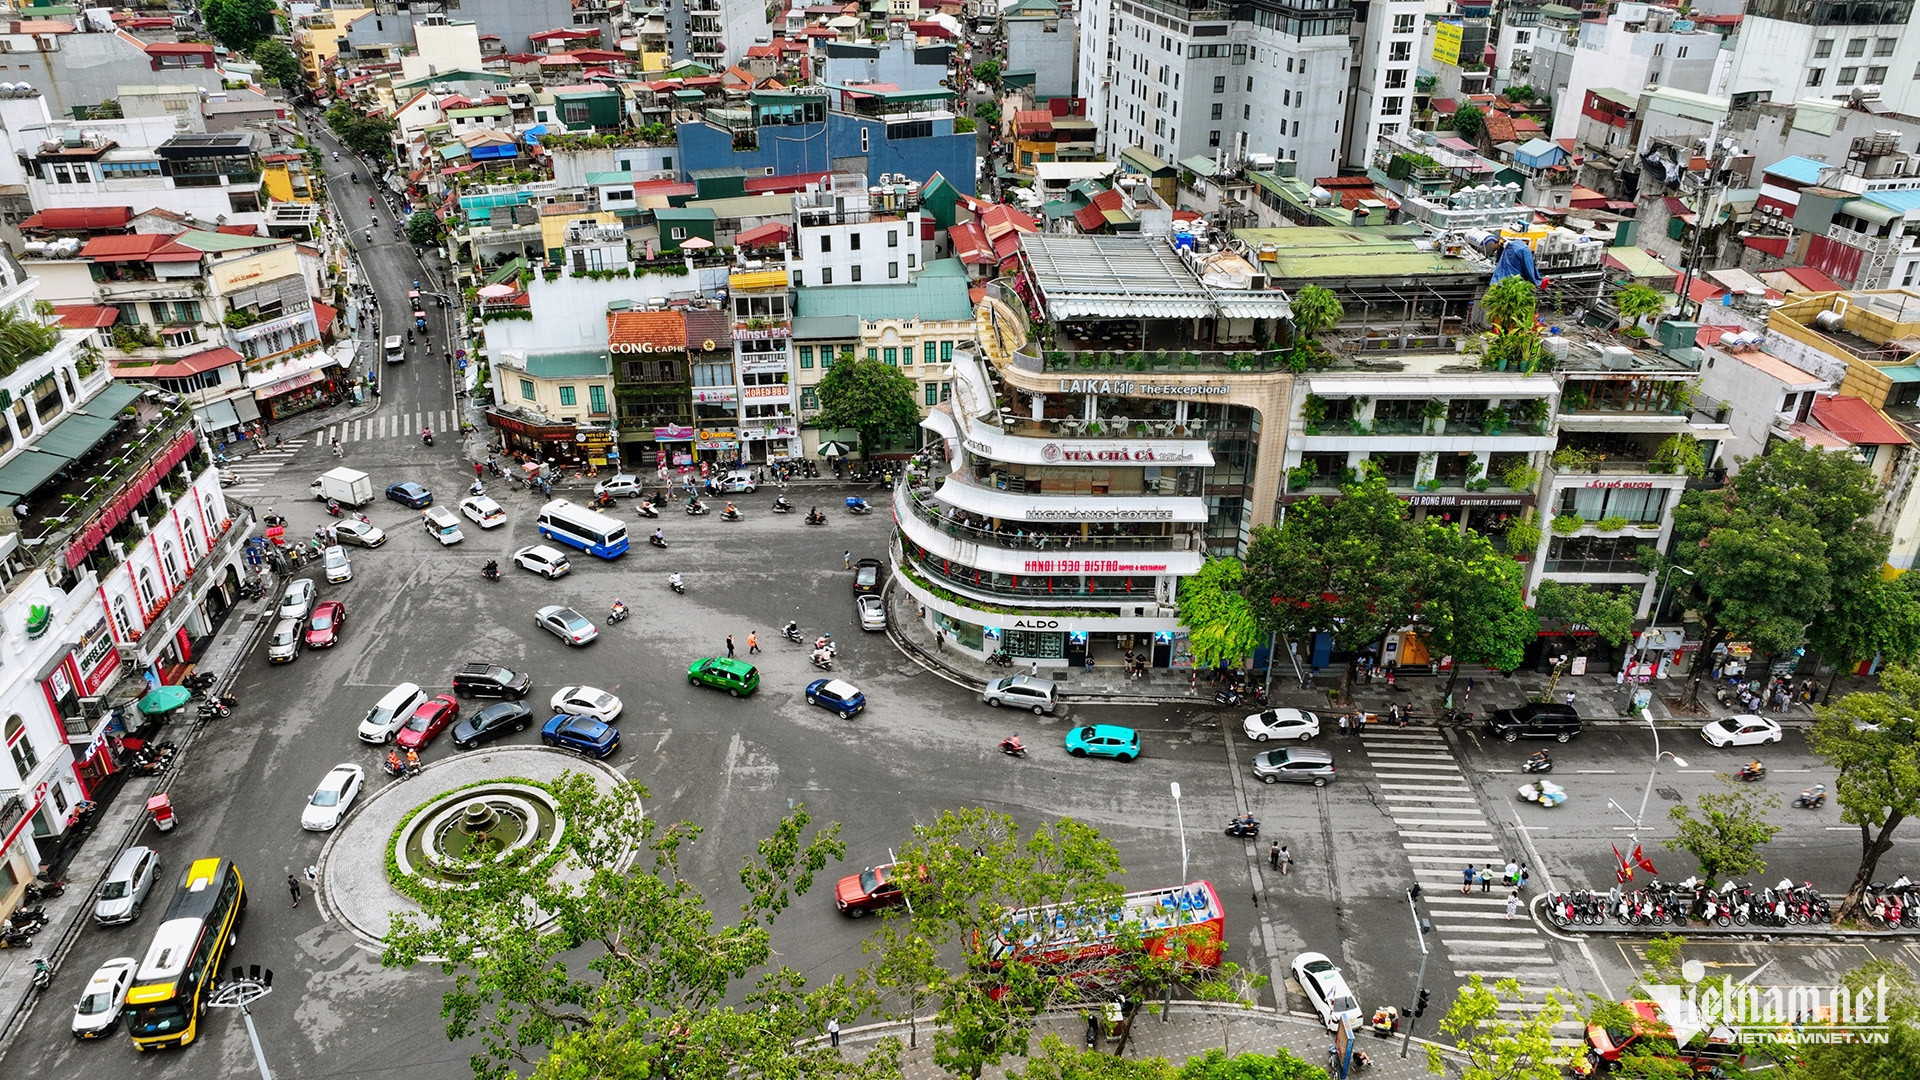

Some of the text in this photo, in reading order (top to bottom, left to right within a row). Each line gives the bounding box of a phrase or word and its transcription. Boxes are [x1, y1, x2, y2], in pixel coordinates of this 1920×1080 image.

[732, 328, 768, 340] Minsu
[1059, 379, 1230, 395] LAIKA Café The Exceptional
[1064, 451, 1094, 461] VUA
[1098, 448, 1130, 461] CHẢ
[1135, 448, 1155, 461] CÁ
[1410, 497, 1420, 505] FU
[1420, 497, 1439, 505] RONG
[1441, 497, 1456, 505] HUA
[1026, 510, 1173, 519] HIGHLANDS COFFEE
[1025, 560, 1054, 571] HANOI
[1058, 560, 1080, 571] 1930
[1084, 560, 1118, 571] BISTRO
[1014, 620, 1058, 629] ALDO
[84, 732, 102, 762] KFC
